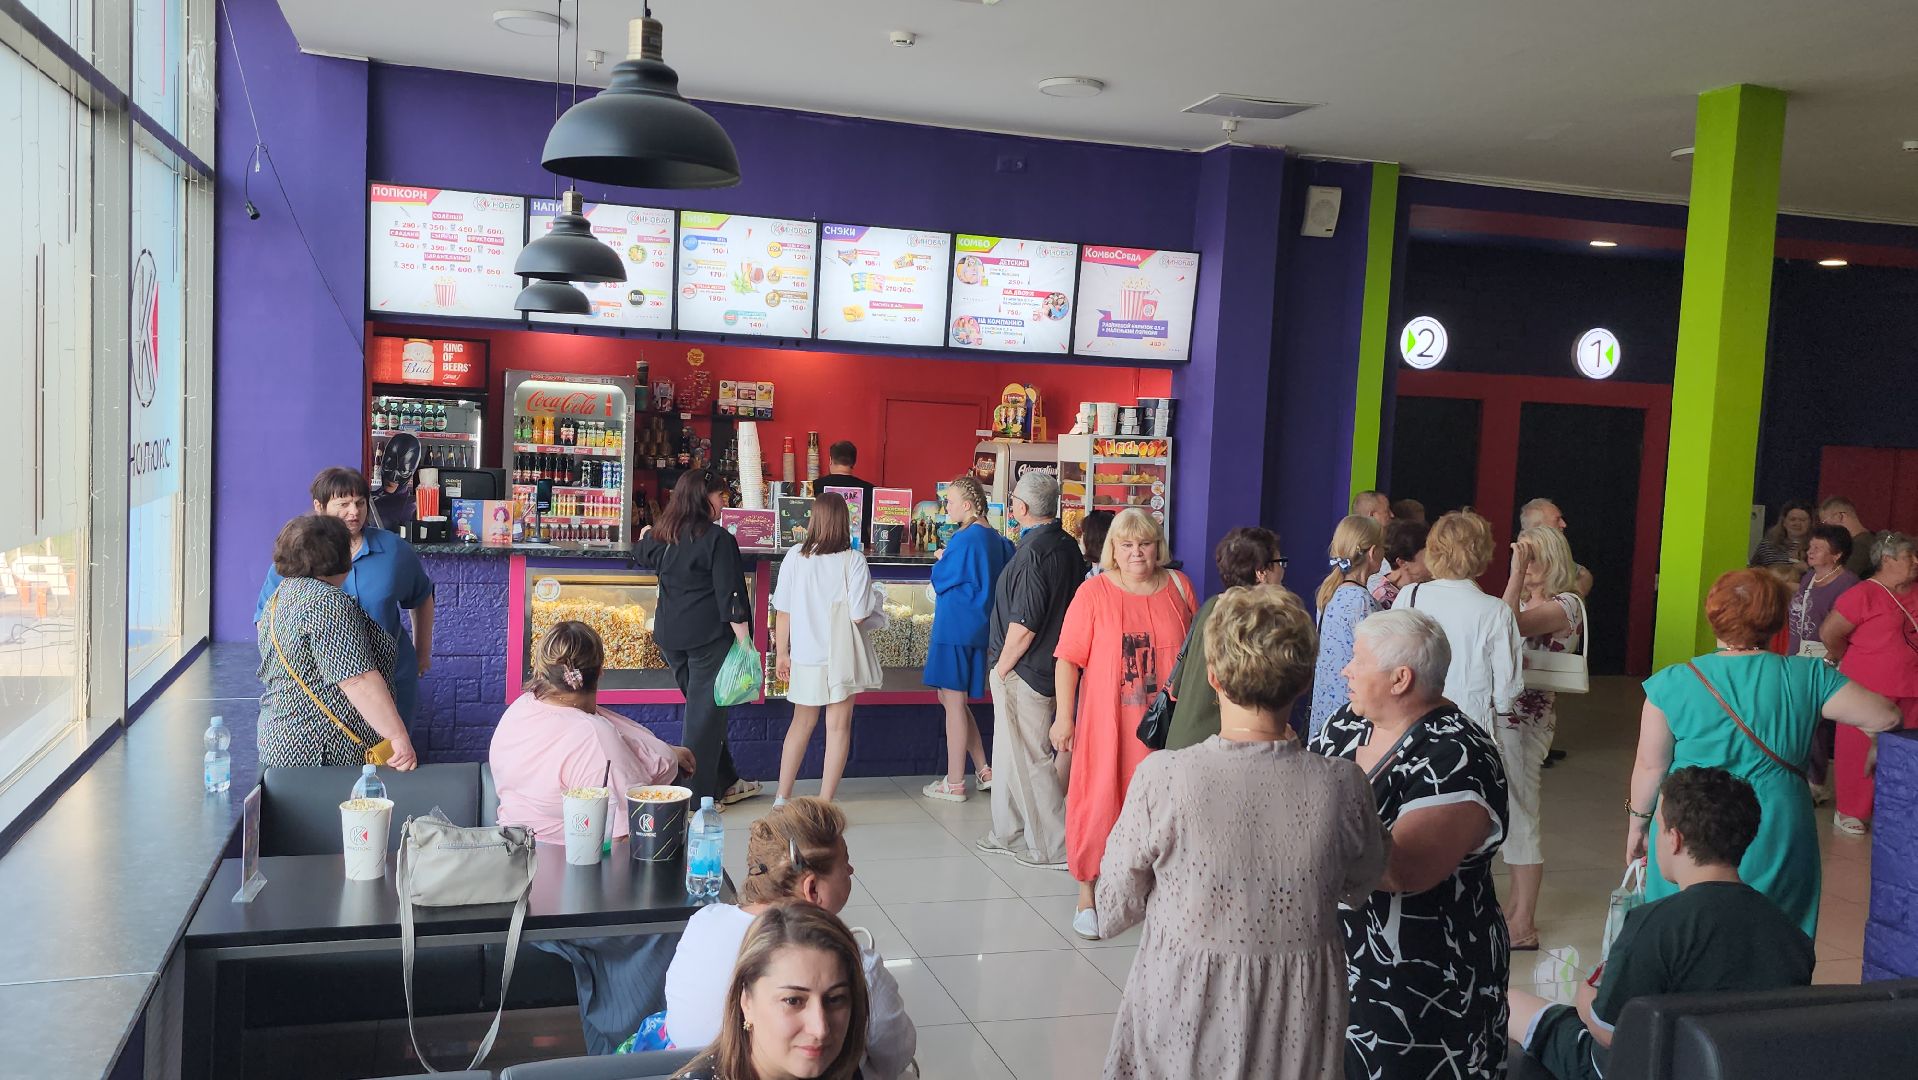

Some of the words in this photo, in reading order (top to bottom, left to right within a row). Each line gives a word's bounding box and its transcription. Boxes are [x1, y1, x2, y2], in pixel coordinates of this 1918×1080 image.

[372, 186, 428, 200] ПОПКОРН
[532, 201, 562, 213] НАПИ
[824, 225, 856, 237] СНЭКИ
[959, 237, 991, 248] КОМБО
[443, 342, 463, 352] KING
[1416, 328, 1434, 358] 2
[442, 352, 454, 362] OF
[1590, 339, 1602, 368] 1
[404, 362, 432, 374] Bud
[442, 362, 469, 373] BEERS
[1105, 439, 1156, 457] Nachos
